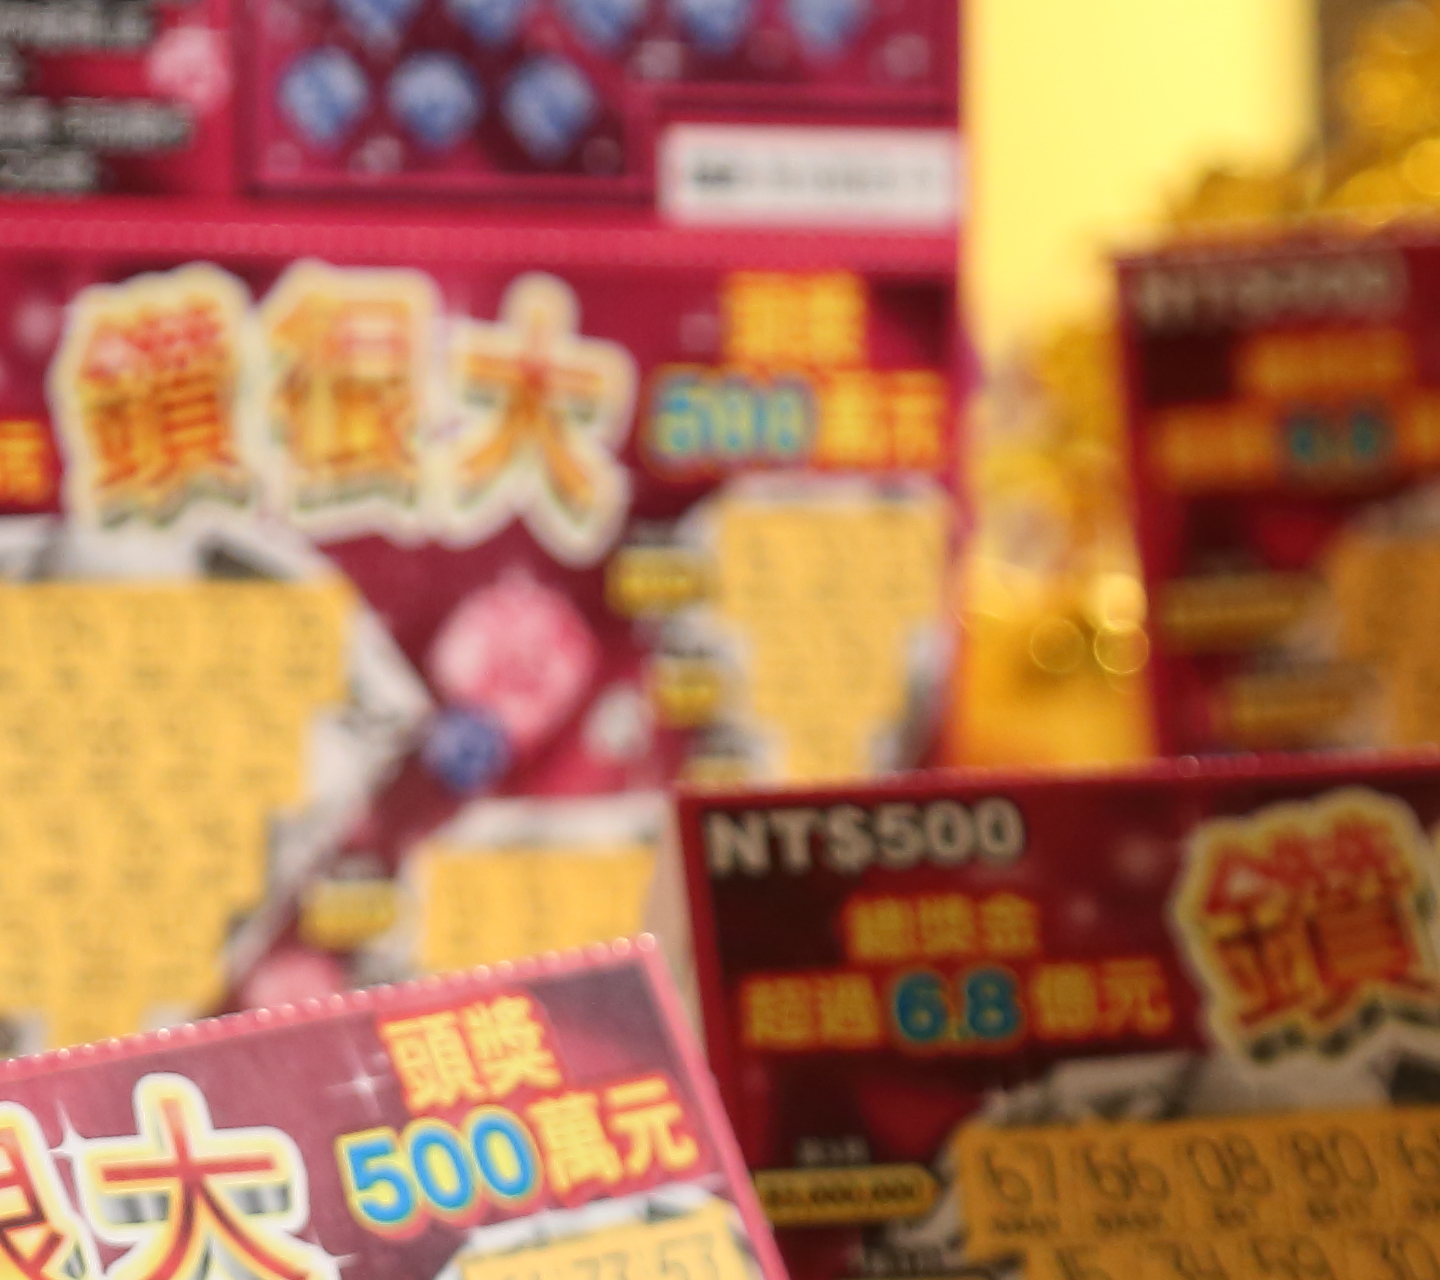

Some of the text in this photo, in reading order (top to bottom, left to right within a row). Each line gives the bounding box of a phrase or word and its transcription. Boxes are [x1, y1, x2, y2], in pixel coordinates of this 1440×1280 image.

[707, 800, 1024, 874] NT$500
[381, 996, 563, 1115] 頭獎
[343, 1078, 699, 1227] 500萬元
